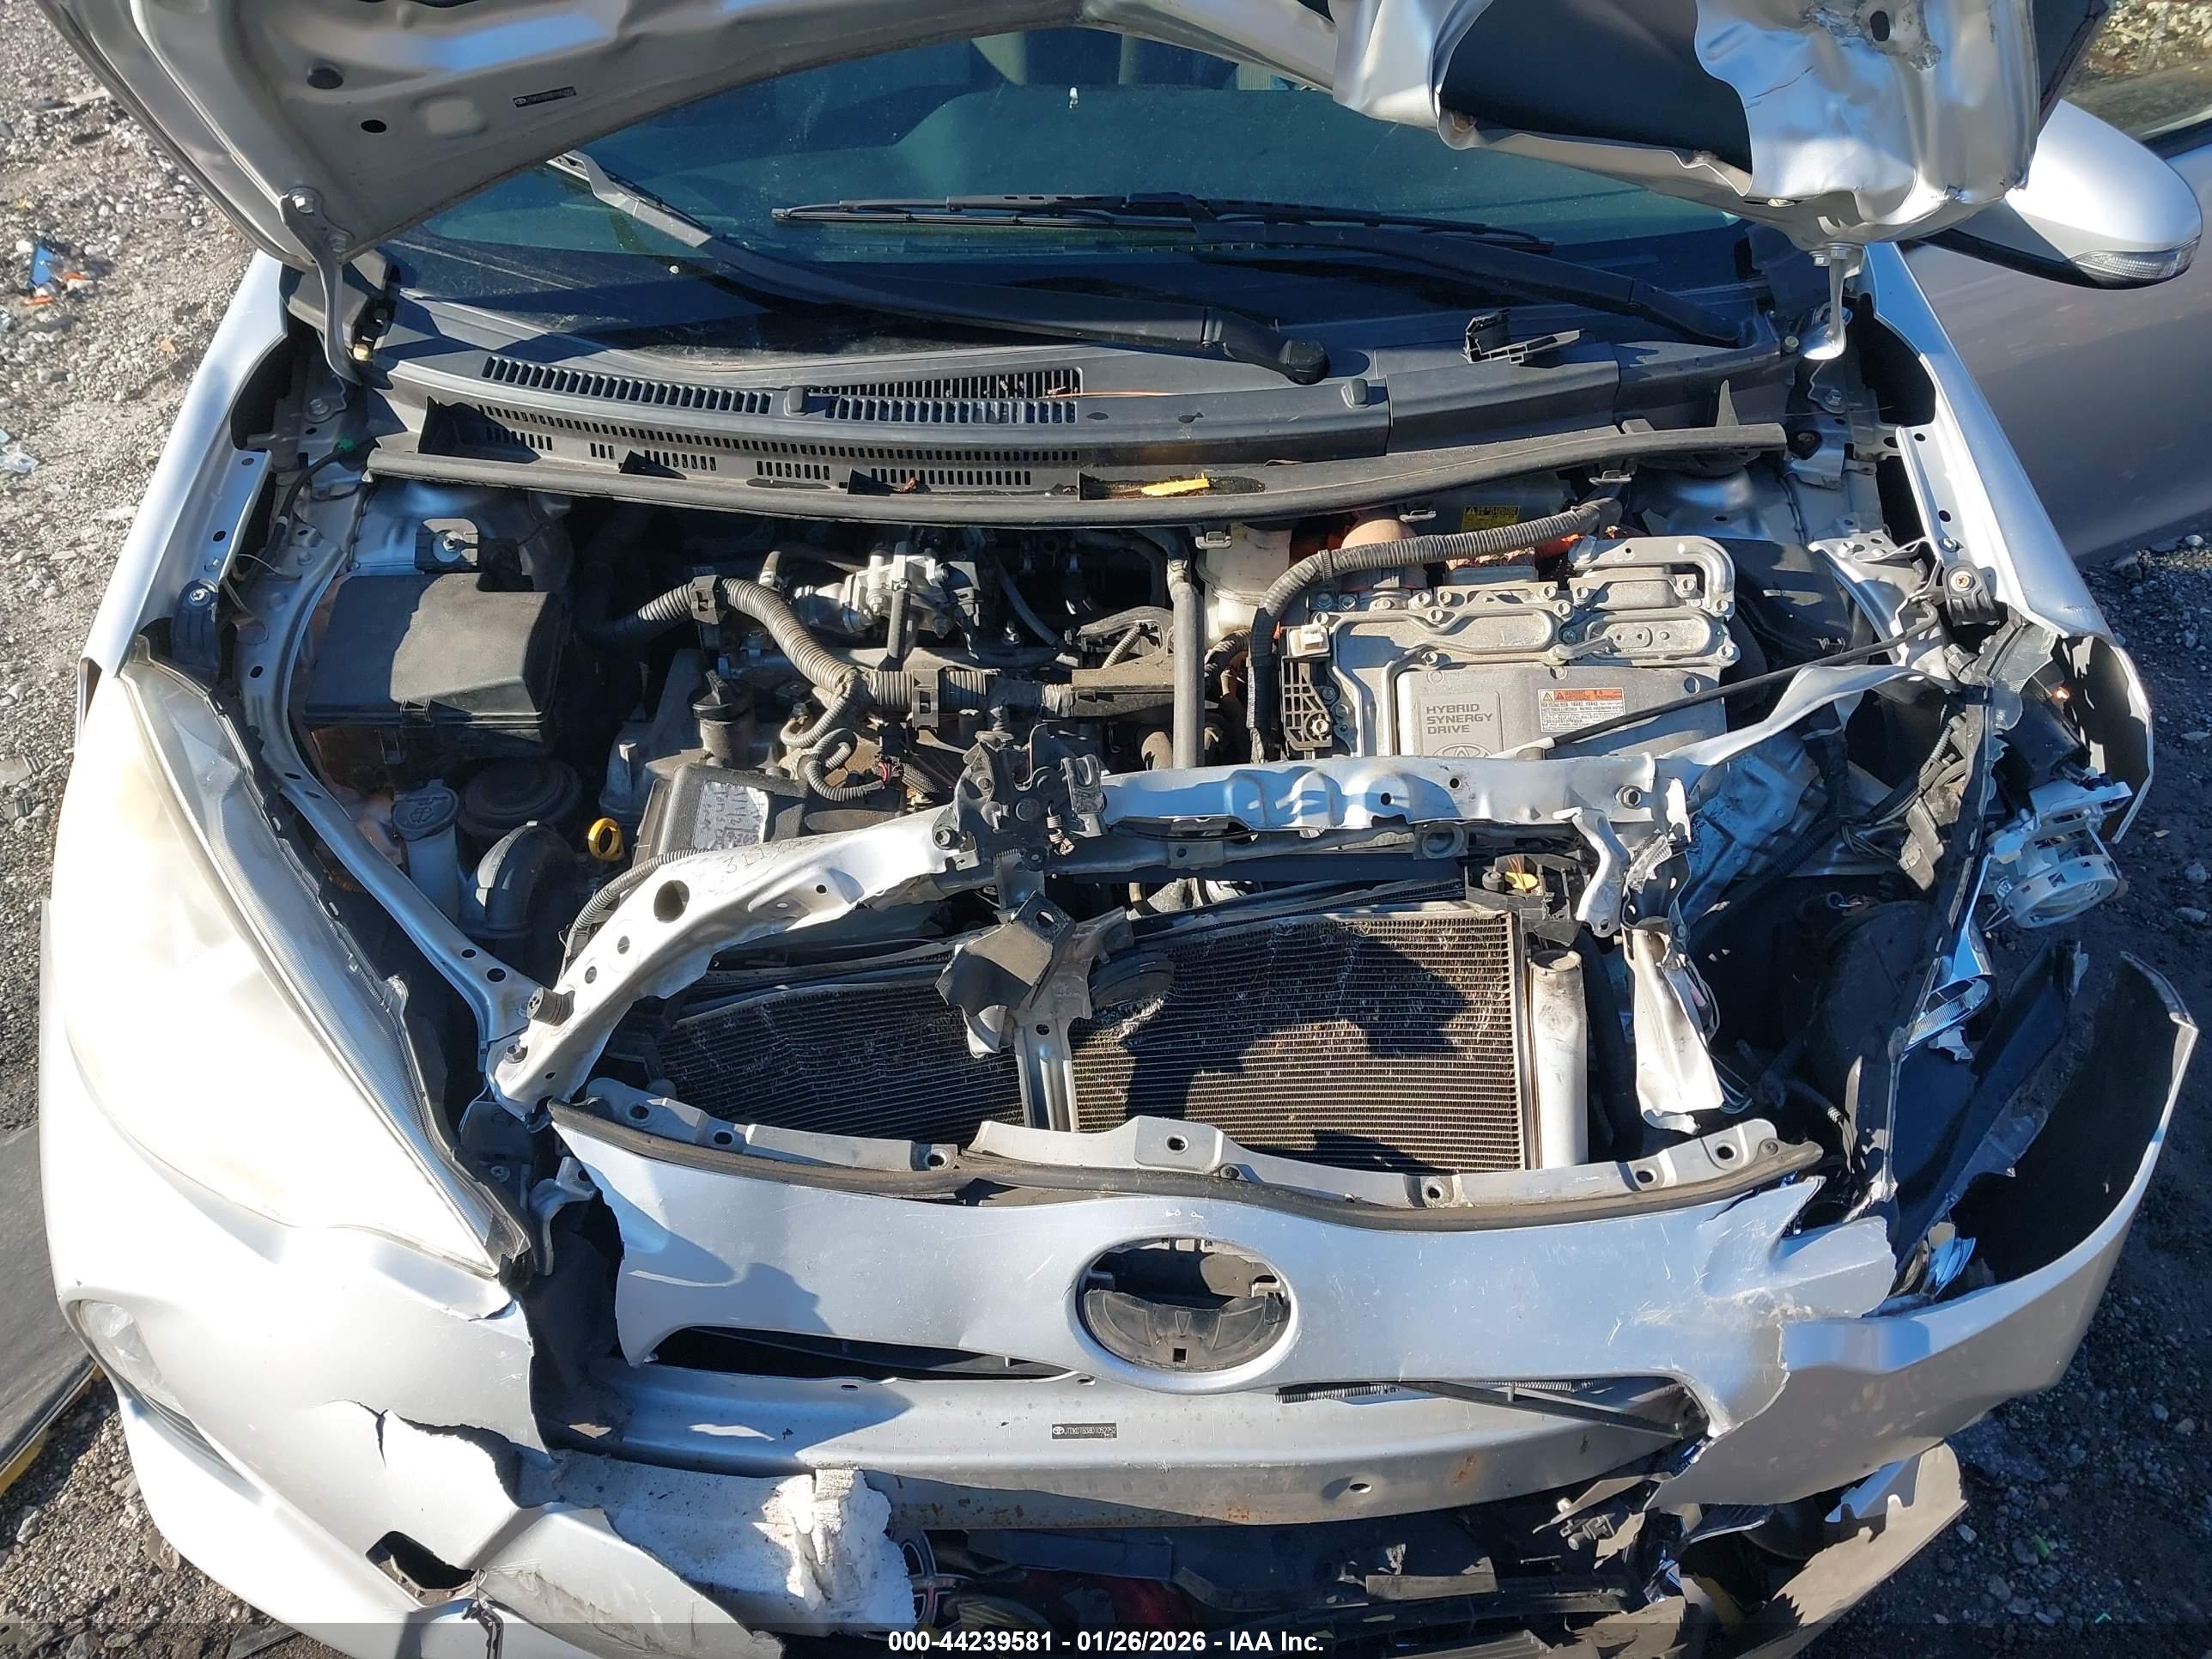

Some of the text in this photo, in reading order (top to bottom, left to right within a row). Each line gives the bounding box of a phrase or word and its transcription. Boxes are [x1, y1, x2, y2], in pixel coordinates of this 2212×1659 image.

[1426, 703, 1480, 714] HYBRID
[1426, 713, 1493, 725] SYNERGY
[1427, 725, 1470, 734] DRIVE
